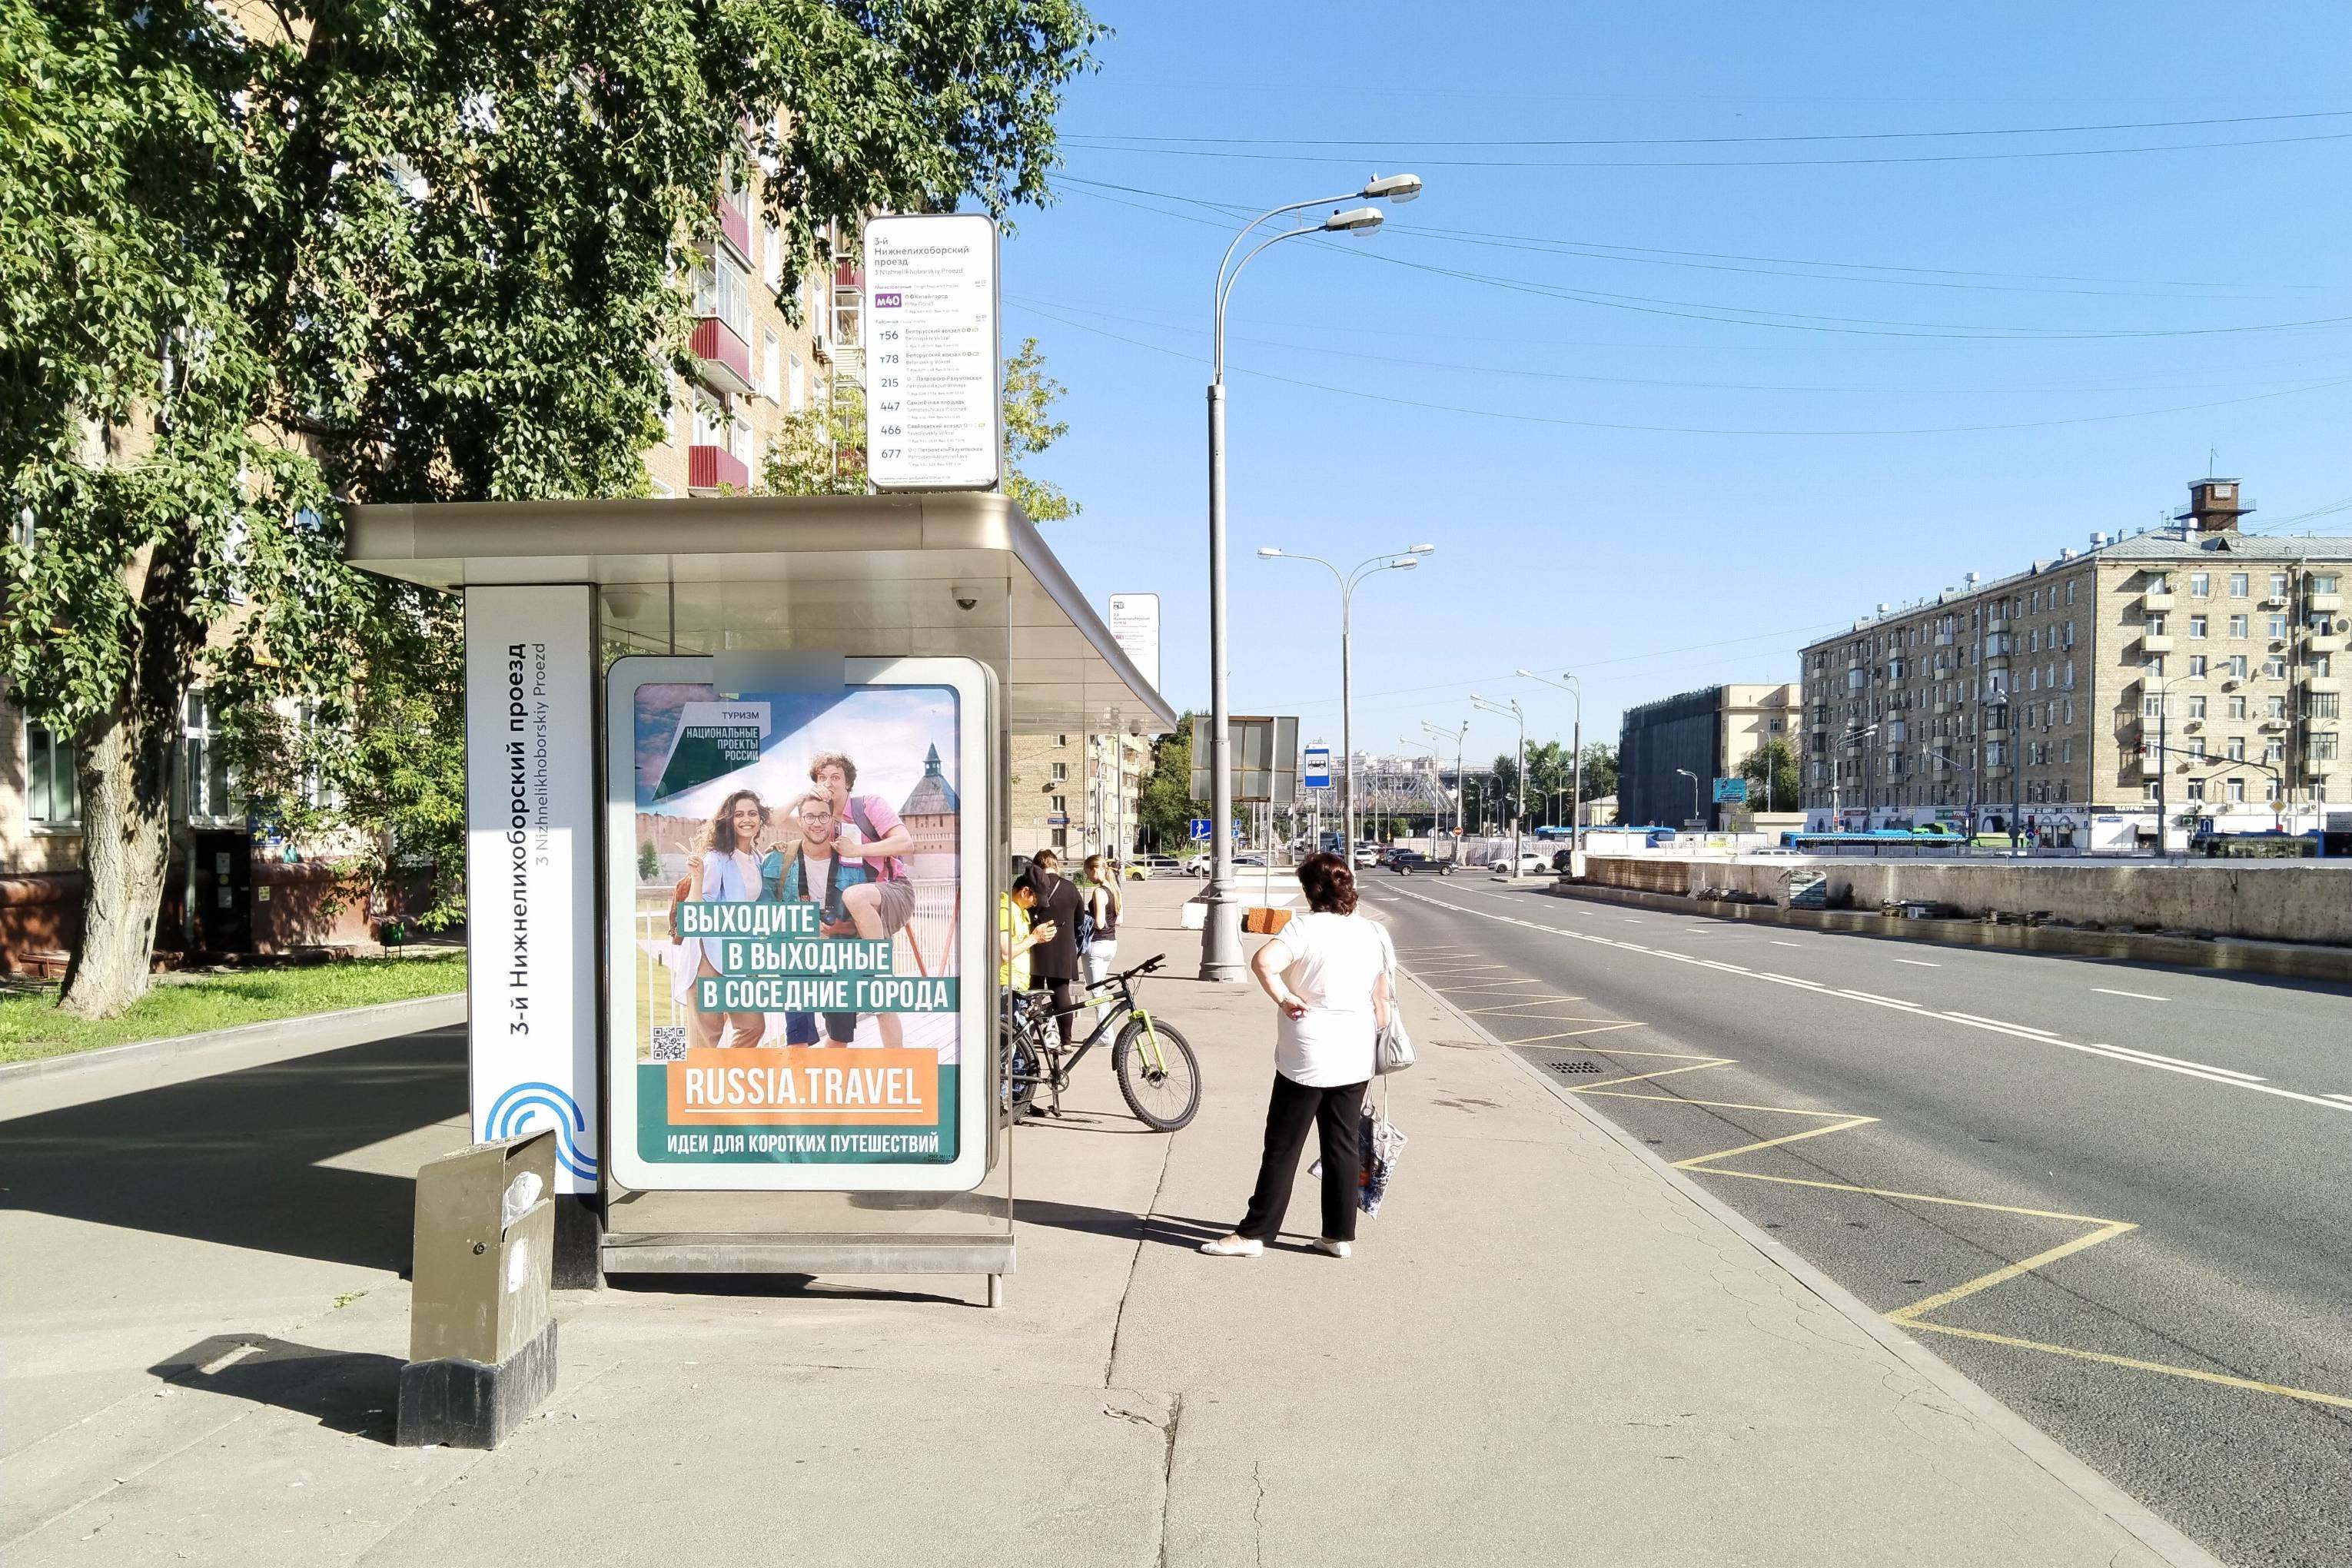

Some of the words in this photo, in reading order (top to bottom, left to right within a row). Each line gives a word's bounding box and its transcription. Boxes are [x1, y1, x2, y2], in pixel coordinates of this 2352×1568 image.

[874, 237, 889, 245] 3-й
[874, 245, 969, 257] Нижнелихоборский
[875, 257, 909, 267] проезд
[882, 379, 899, 387] 215
[880, 402, 899, 411] 447
[881, 426, 901, 435] 466
[882, 450, 901, 458] 677
[531, 643, 546, 696] Proezd
[509, 643, 528, 731] проезд
[686, 727, 758, 739] НАЦИОНАЛЬНЫЕ
[717, 739, 758, 749] ПРОЕКТЫ
[725, 750, 759, 761] РОССИИ
[533, 702, 549, 850] Nizhnelikhoborskiy
[506, 742, 530, 987] Нижнелихоборский
[536, 856, 549, 865] 3
[683, 905, 815, 935] ВЫХОДИТЕ
[729, 943, 742, 970] В
[750, 942, 889, 973] ВЫХОДНЫЕ
[703, 981, 718, 1008] В
[726, 980, 849, 1011] СОСЕДНИЕ
[856, 980, 948, 1011] ГОРОДА
[510, 997, 529, 1035] 3-й
[685, 1067, 922, 1105] RUSSIA.TRAVEL
[667, 1134, 708, 1154] ИДЕИ
[713, 1134, 744, 1154] ДЛЯ
[749, 1134, 826, 1153] КОРОТКИХ
[830, 1131, 938, 1153] ПУТЕШЕСТВИЙ
